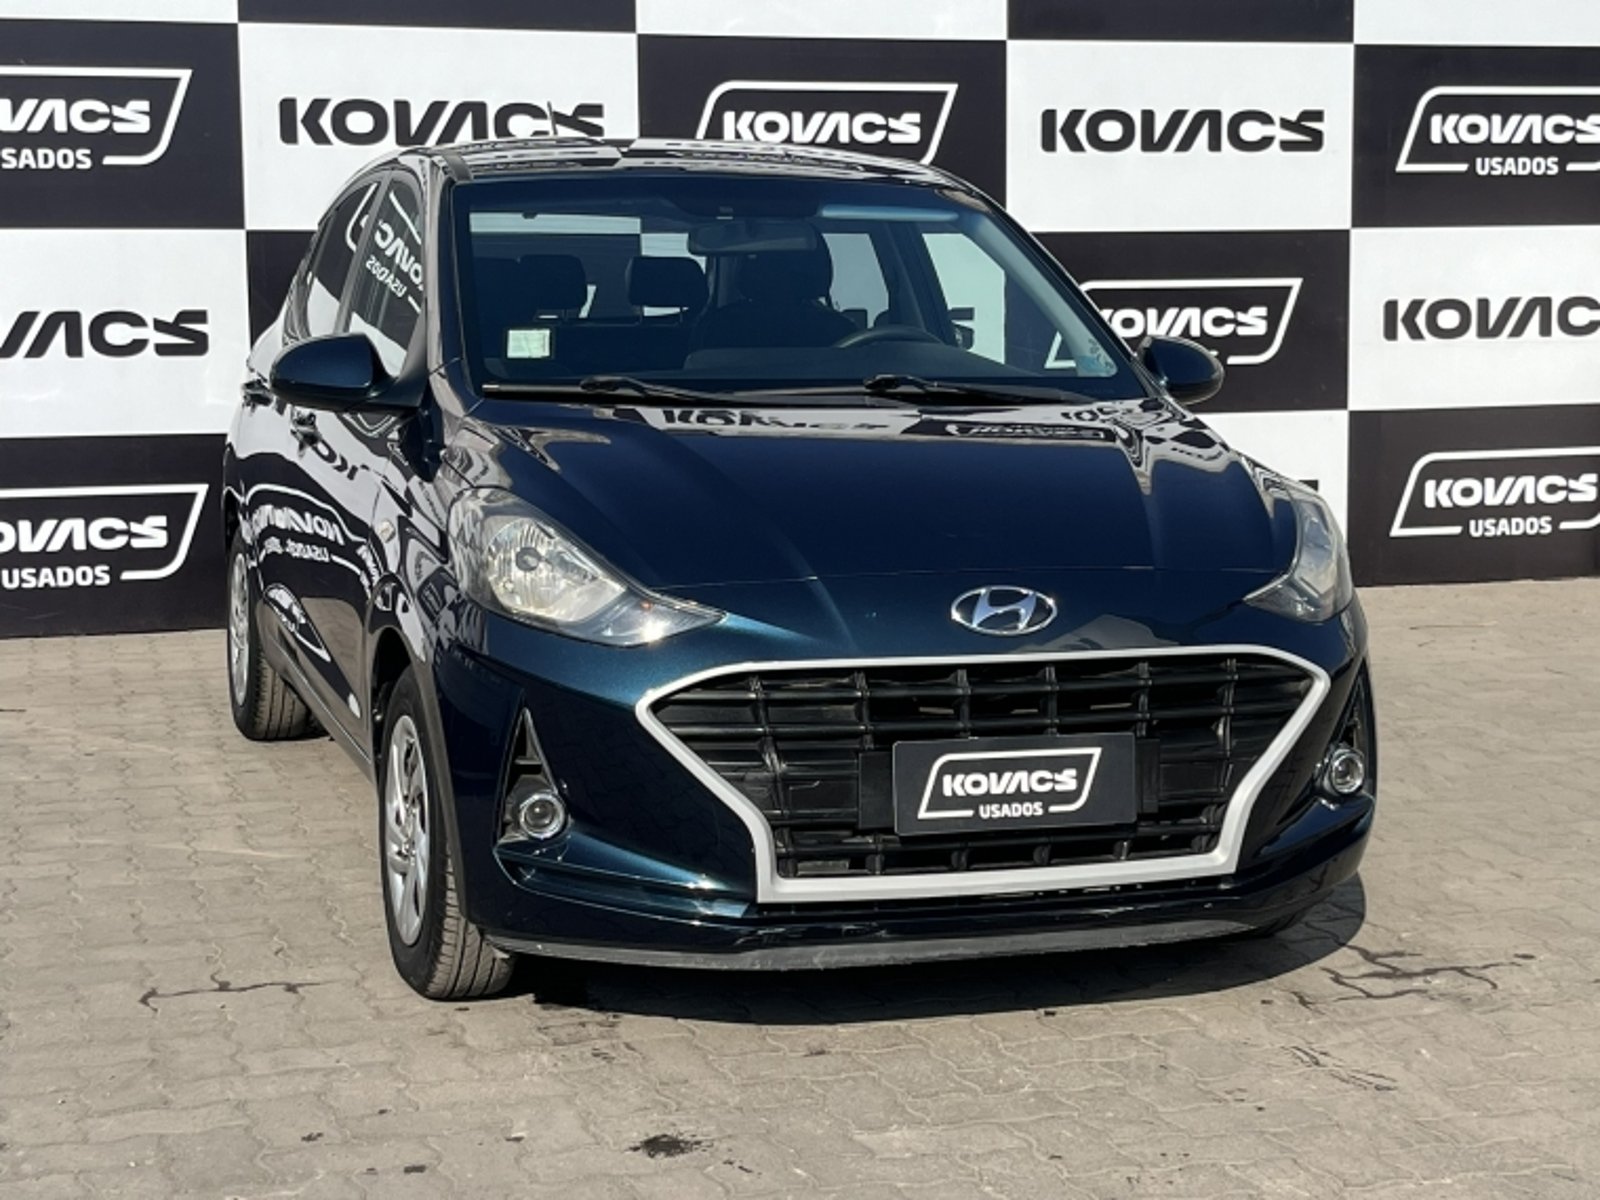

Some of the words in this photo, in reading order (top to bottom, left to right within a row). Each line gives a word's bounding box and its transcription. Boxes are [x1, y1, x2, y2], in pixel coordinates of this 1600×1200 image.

[279, 97, 604, 146] KOVACS
[723, 111, 921, 144] KOVACS
[1041, 109, 1324, 152] KOVACS
[1430, 113, 1600, 144] KOVACS
[1475, 157, 1559, 176] USADOS
[1100, 306, 1268, 338] OVACS
[1383, 296, 1600, 341] KOVAC
[1424, 473, 1598, 508] KOVACS
[1469, 516, 1552, 537] USADOS
[2, 565, 111, 589] USADOS
[942, 768, 1077, 797] KOVACS
[979, 802, 1043, 819] USADOS
